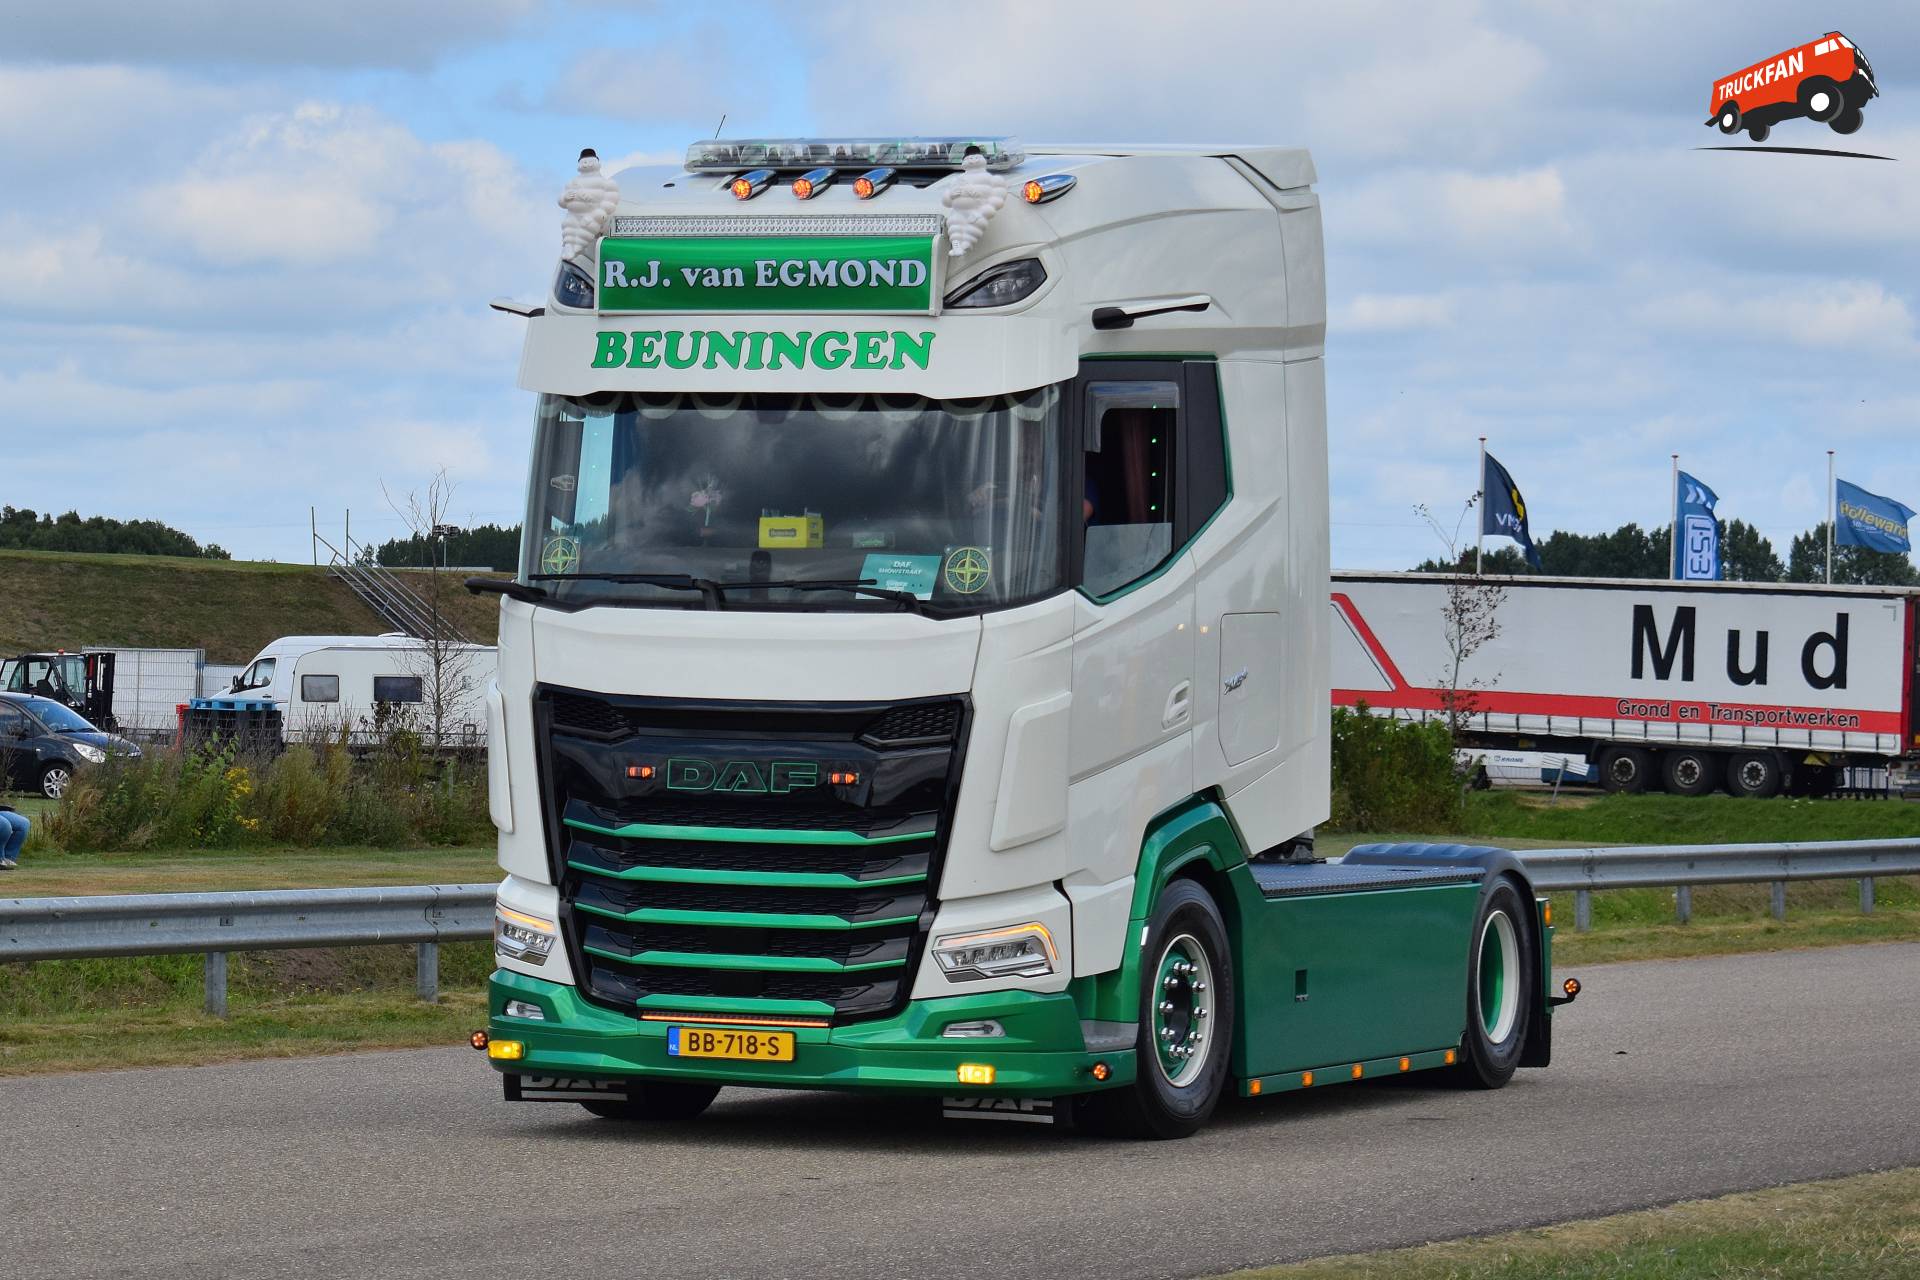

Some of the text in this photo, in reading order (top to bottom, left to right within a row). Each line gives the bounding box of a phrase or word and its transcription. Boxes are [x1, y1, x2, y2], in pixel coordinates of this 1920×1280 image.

[603, 259, 927, 288] R.J. van EGMOND
[591, 330, 936, 370] BEUNINGEN
[893, 560, 912, 568] DAF
[1631, 604, 1849, 690] Mud
[1617, 700, 1859, 727] Grond en Transportwerken
[666, 758, 818, 793] DAF
[688, 1032, 780, 1056] BB-718-S
